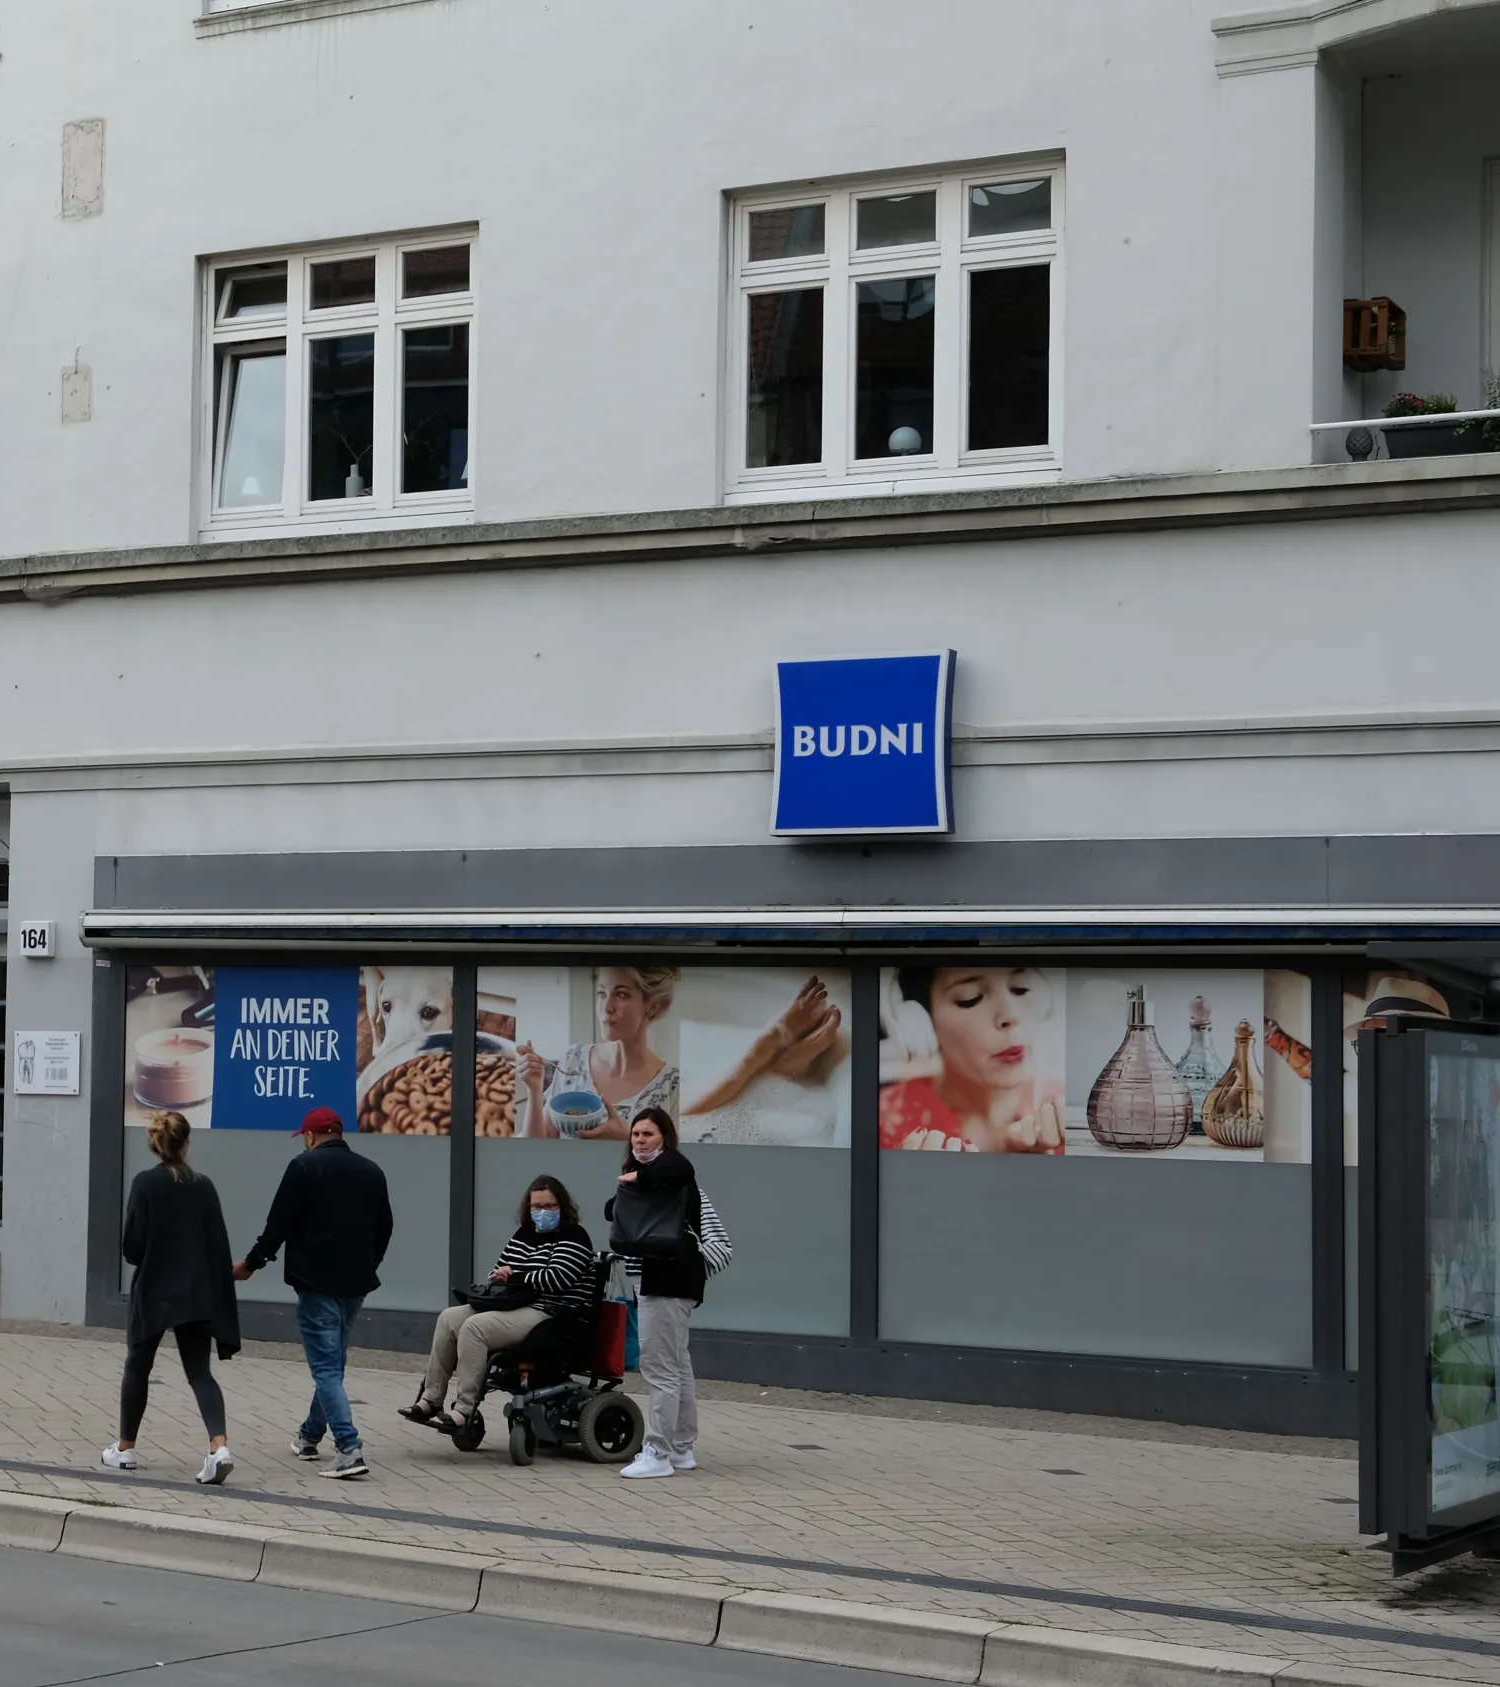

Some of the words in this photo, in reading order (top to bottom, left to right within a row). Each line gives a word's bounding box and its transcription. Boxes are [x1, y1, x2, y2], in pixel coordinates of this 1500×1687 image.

[792, 722, 923, 758] BUDNI
[20, 928, 47, 949] 164
[240, 997, 330, 1025] IMMER
[230, 1029, 260, 1061] AN
[267, 1028, 341, 1062] DEINER
[254, 1065, 315, 1099] SEITE.
